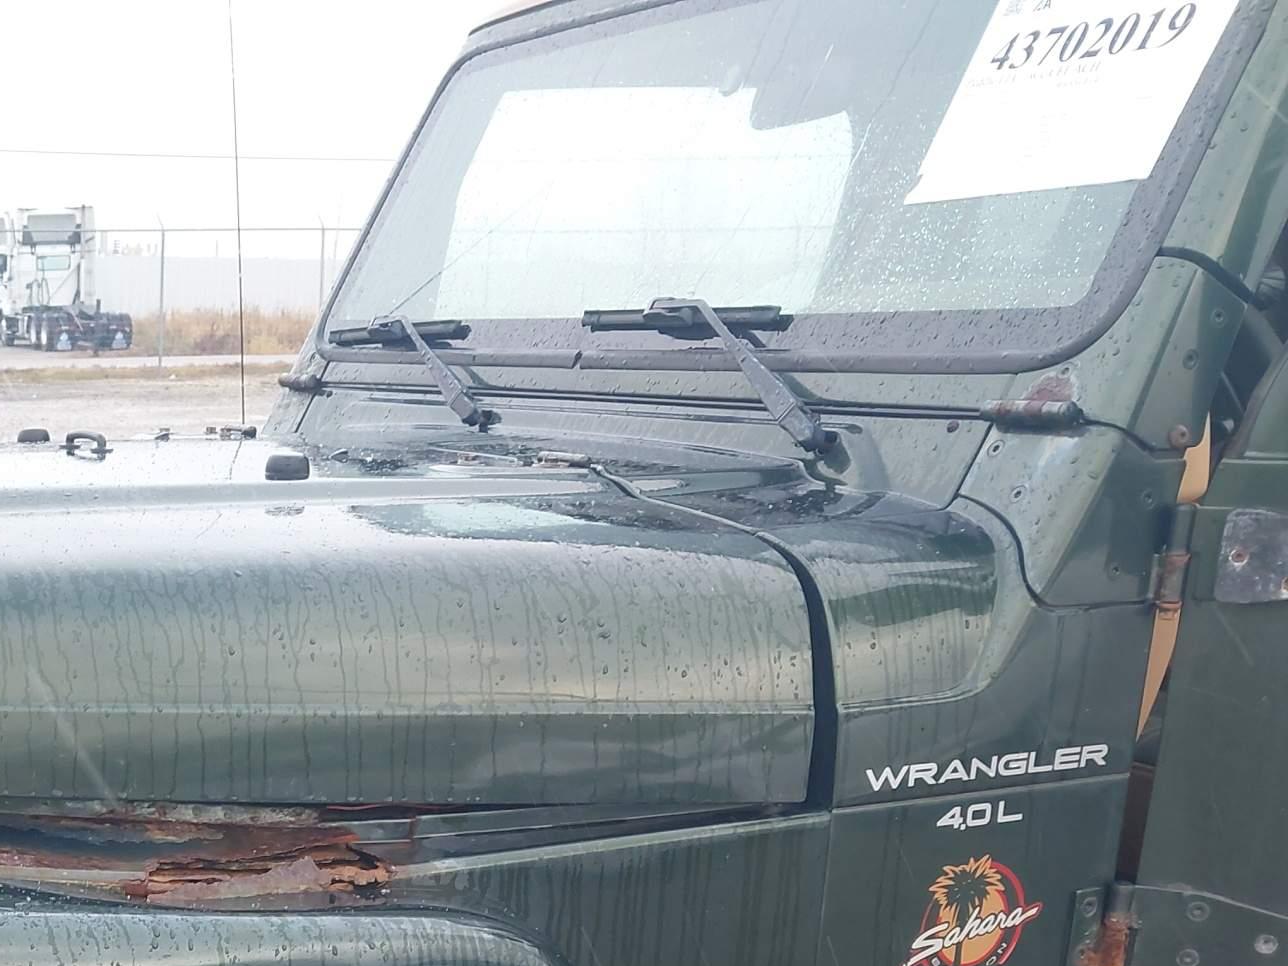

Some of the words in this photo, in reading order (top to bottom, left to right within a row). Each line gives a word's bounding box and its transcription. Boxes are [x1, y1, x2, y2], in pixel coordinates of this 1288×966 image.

[989, 2, 1198, 71] 43702019
[864, 743, 1110, 792] WRANGLER
[901, 904, 1040, 961] Sahara
